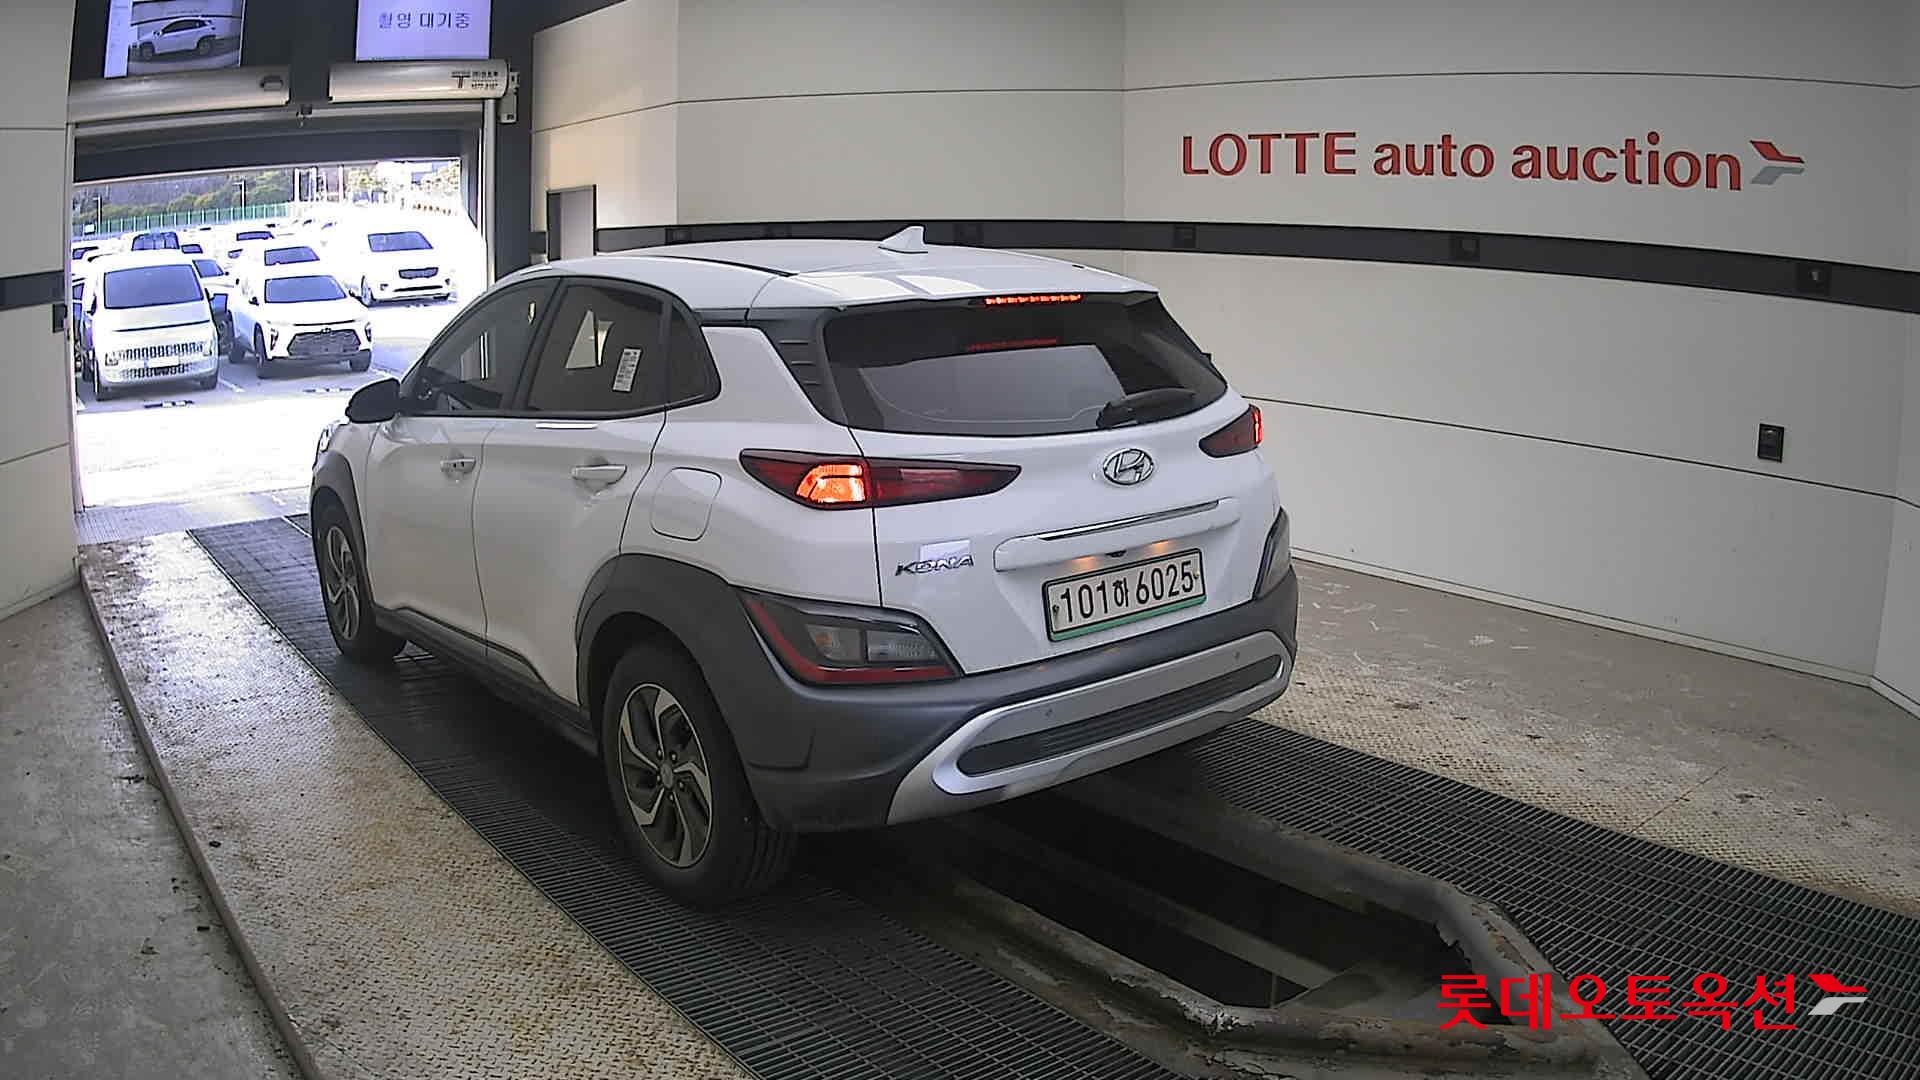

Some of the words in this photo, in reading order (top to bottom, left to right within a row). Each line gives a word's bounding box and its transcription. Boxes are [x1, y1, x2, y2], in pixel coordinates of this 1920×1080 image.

[419, 12, 470, 29] 대기중
[1183, 132, 1357, 176] LOTTE
[1374, 135, 1495, 177] auto
[1511, 132, 1742, 190] auction
[895, 554, 974, 576] KONA
[1060, 577, 1129, 622] 101하
[1136, 560, 1195, 605] 6025
